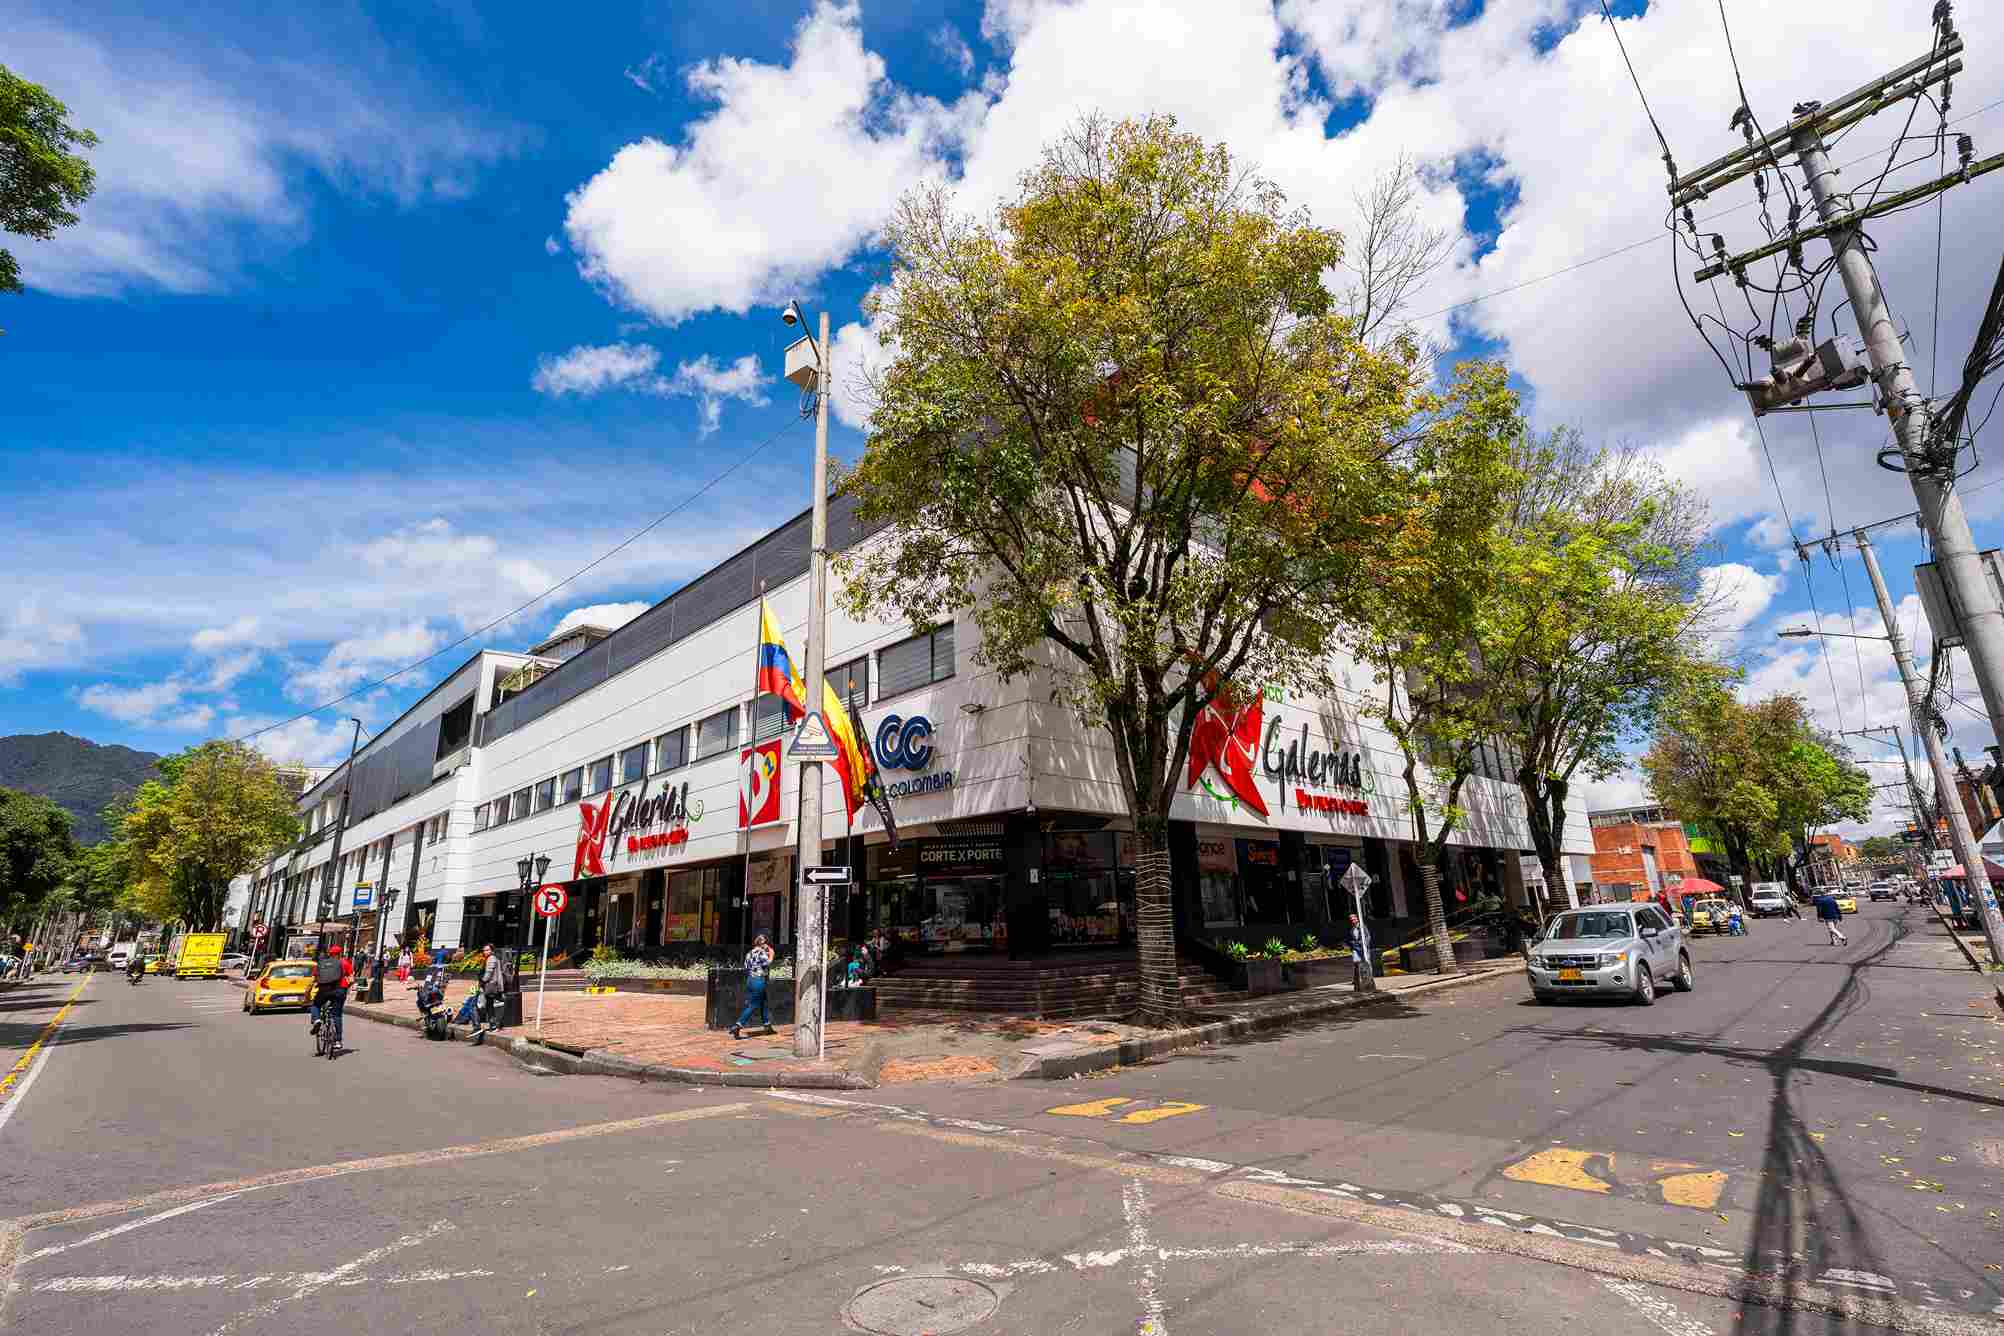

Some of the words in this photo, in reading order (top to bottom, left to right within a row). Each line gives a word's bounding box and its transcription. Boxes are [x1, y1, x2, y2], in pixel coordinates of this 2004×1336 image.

[889, 771, 953, 799] COLOMBIA
[920, 850, 957, 862] CORTE
[958, 850, 966, 861] X
